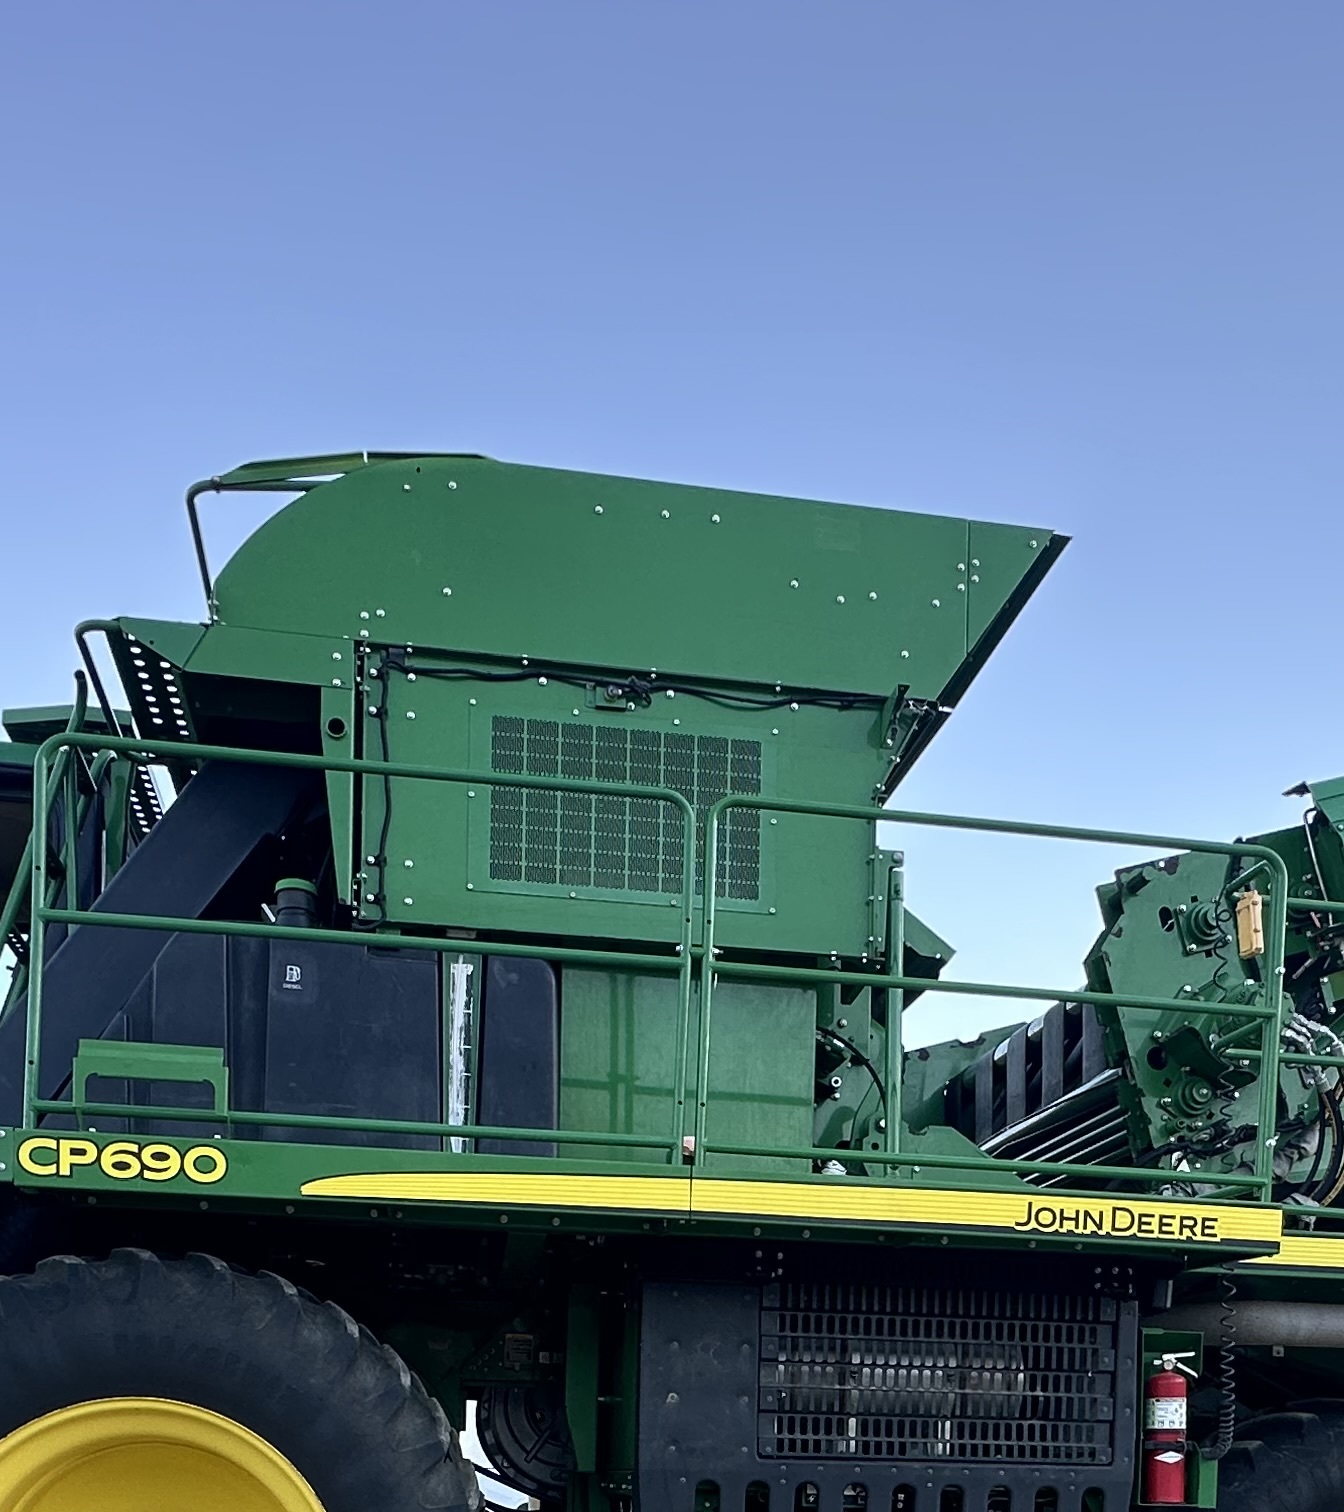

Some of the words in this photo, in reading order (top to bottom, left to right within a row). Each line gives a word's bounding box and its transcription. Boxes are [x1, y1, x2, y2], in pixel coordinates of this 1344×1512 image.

[17, 1136, 229, 1185] CP690
[1014, 1201, 1104, 1231] JOHN
[1111, 1206, 1219, 1238] DEERE
